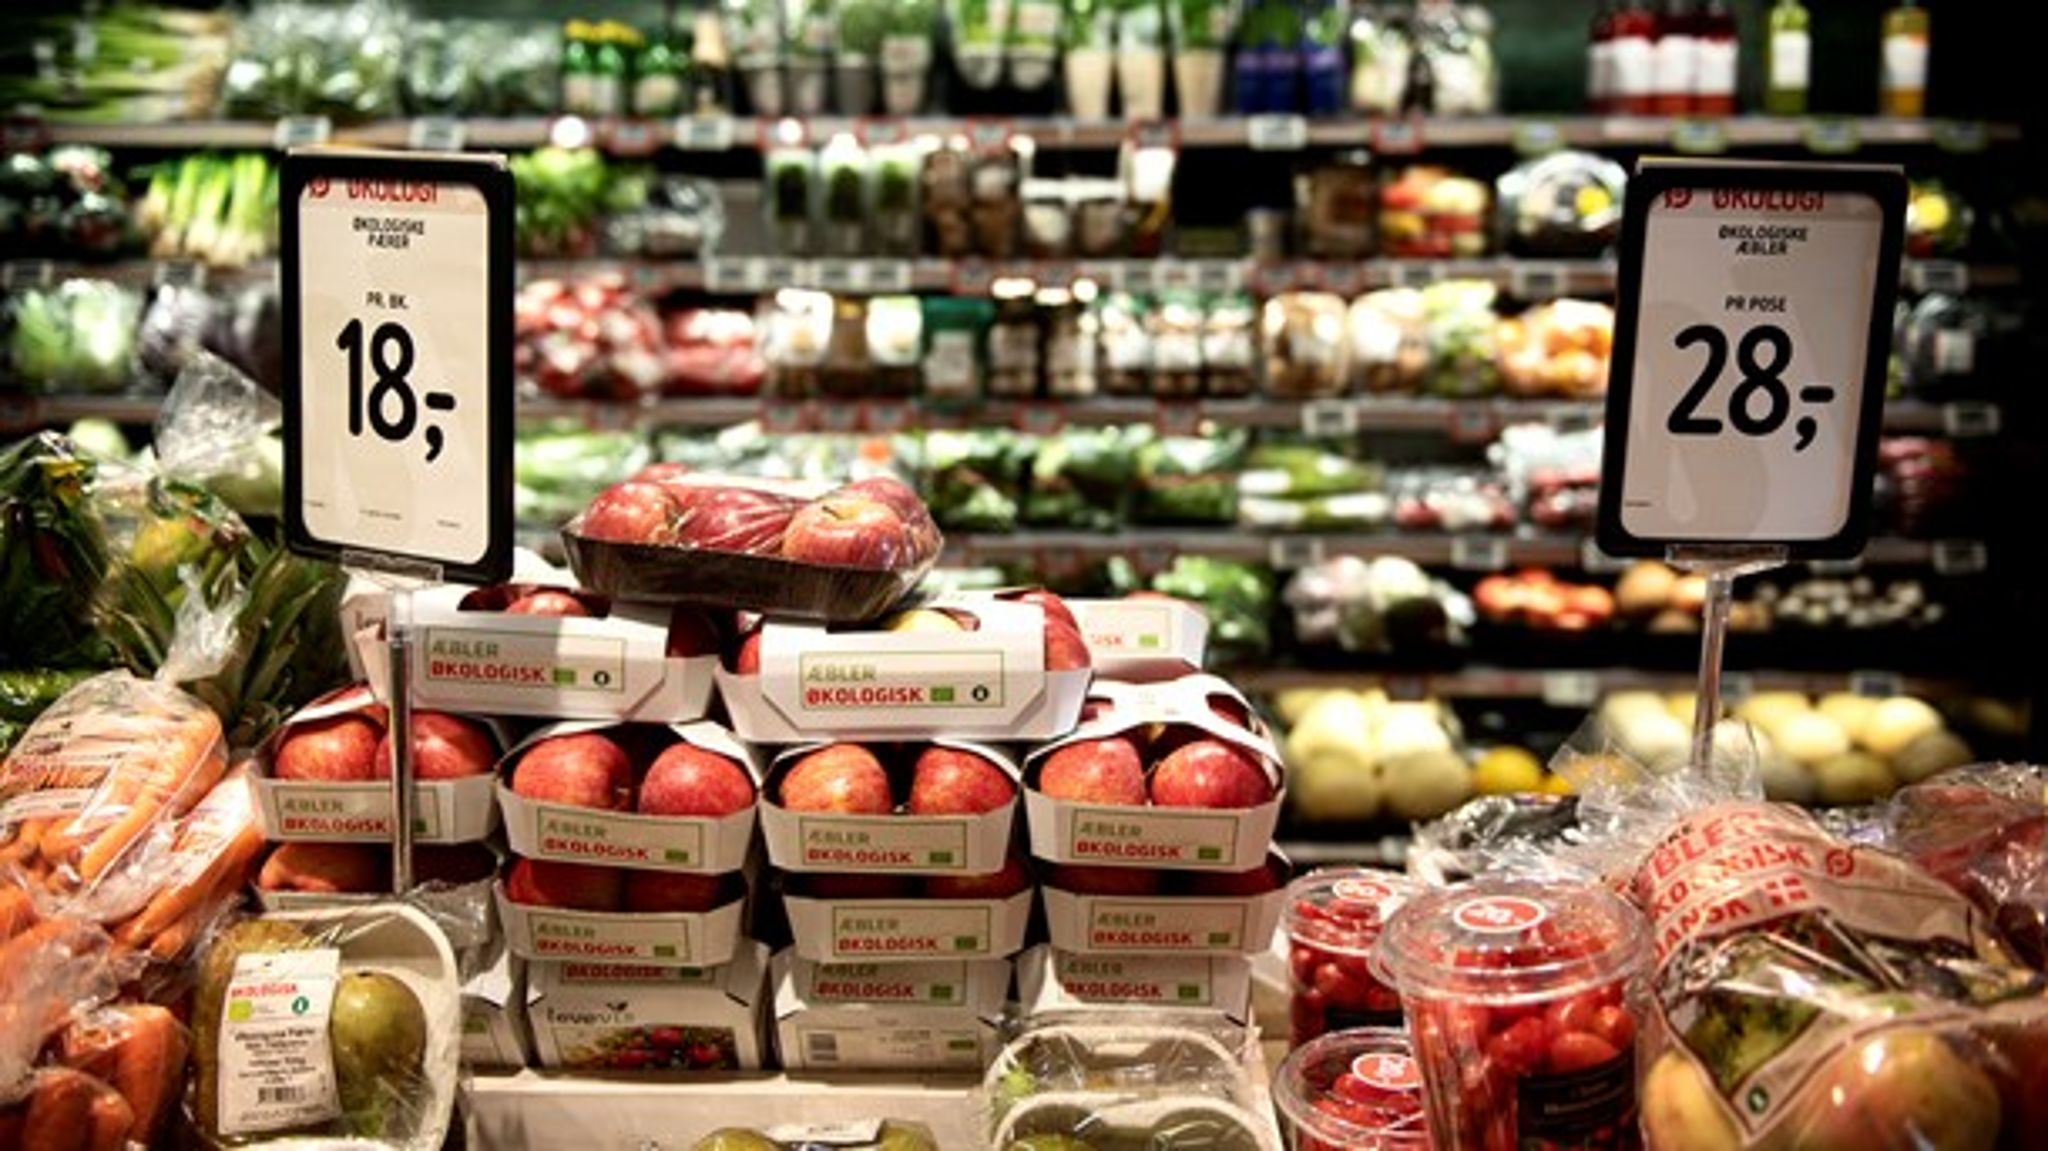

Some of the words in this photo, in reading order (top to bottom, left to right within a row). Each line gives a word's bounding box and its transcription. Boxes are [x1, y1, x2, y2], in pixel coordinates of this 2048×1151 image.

[353, 217, 424, 235] ØKOLOGISKE
[1718, 225, 1808, 242] ØKOLOGISKE
[368, 234, 410, 249] PÆRER
[1736, 240, 1788, 255] ÆBLER
[1750, 298, 1787, 312] POSE
[432, 640, 499, 657] ÆBLER
[432, 661, 546, 682] ØKOLOGISK
[806, 664, 877, 682] ÆBLER
[806, 686, 924, 705] ØKOLOGISK
[284, 819, 387, 832] ØKOLOGISK
[547, 821, 607, 838] ÆBLER
[1080, 821, 1142, 837] ÆBLER
[808, 830, 871, 844] ÆBLER
[544, 838, 649, 859] ØKOLOGISK
[807, 848, 913, 863] ØKOLOGISK
[1077, 842, 1183, 857] ØKOLOGISK
[1098, 912, 1156, 927] ÆBLER
[838, 937, 938, 951] ØKOLOGISK
[1094, 931, 1193, 945] ØKOLOGISK
[537, 939, 636, 956] ØKOLOGISK
[816, 982, 915, 998] ØKOLOGISK
[1065, 981, 1163, 998] ØKOLOGISK
